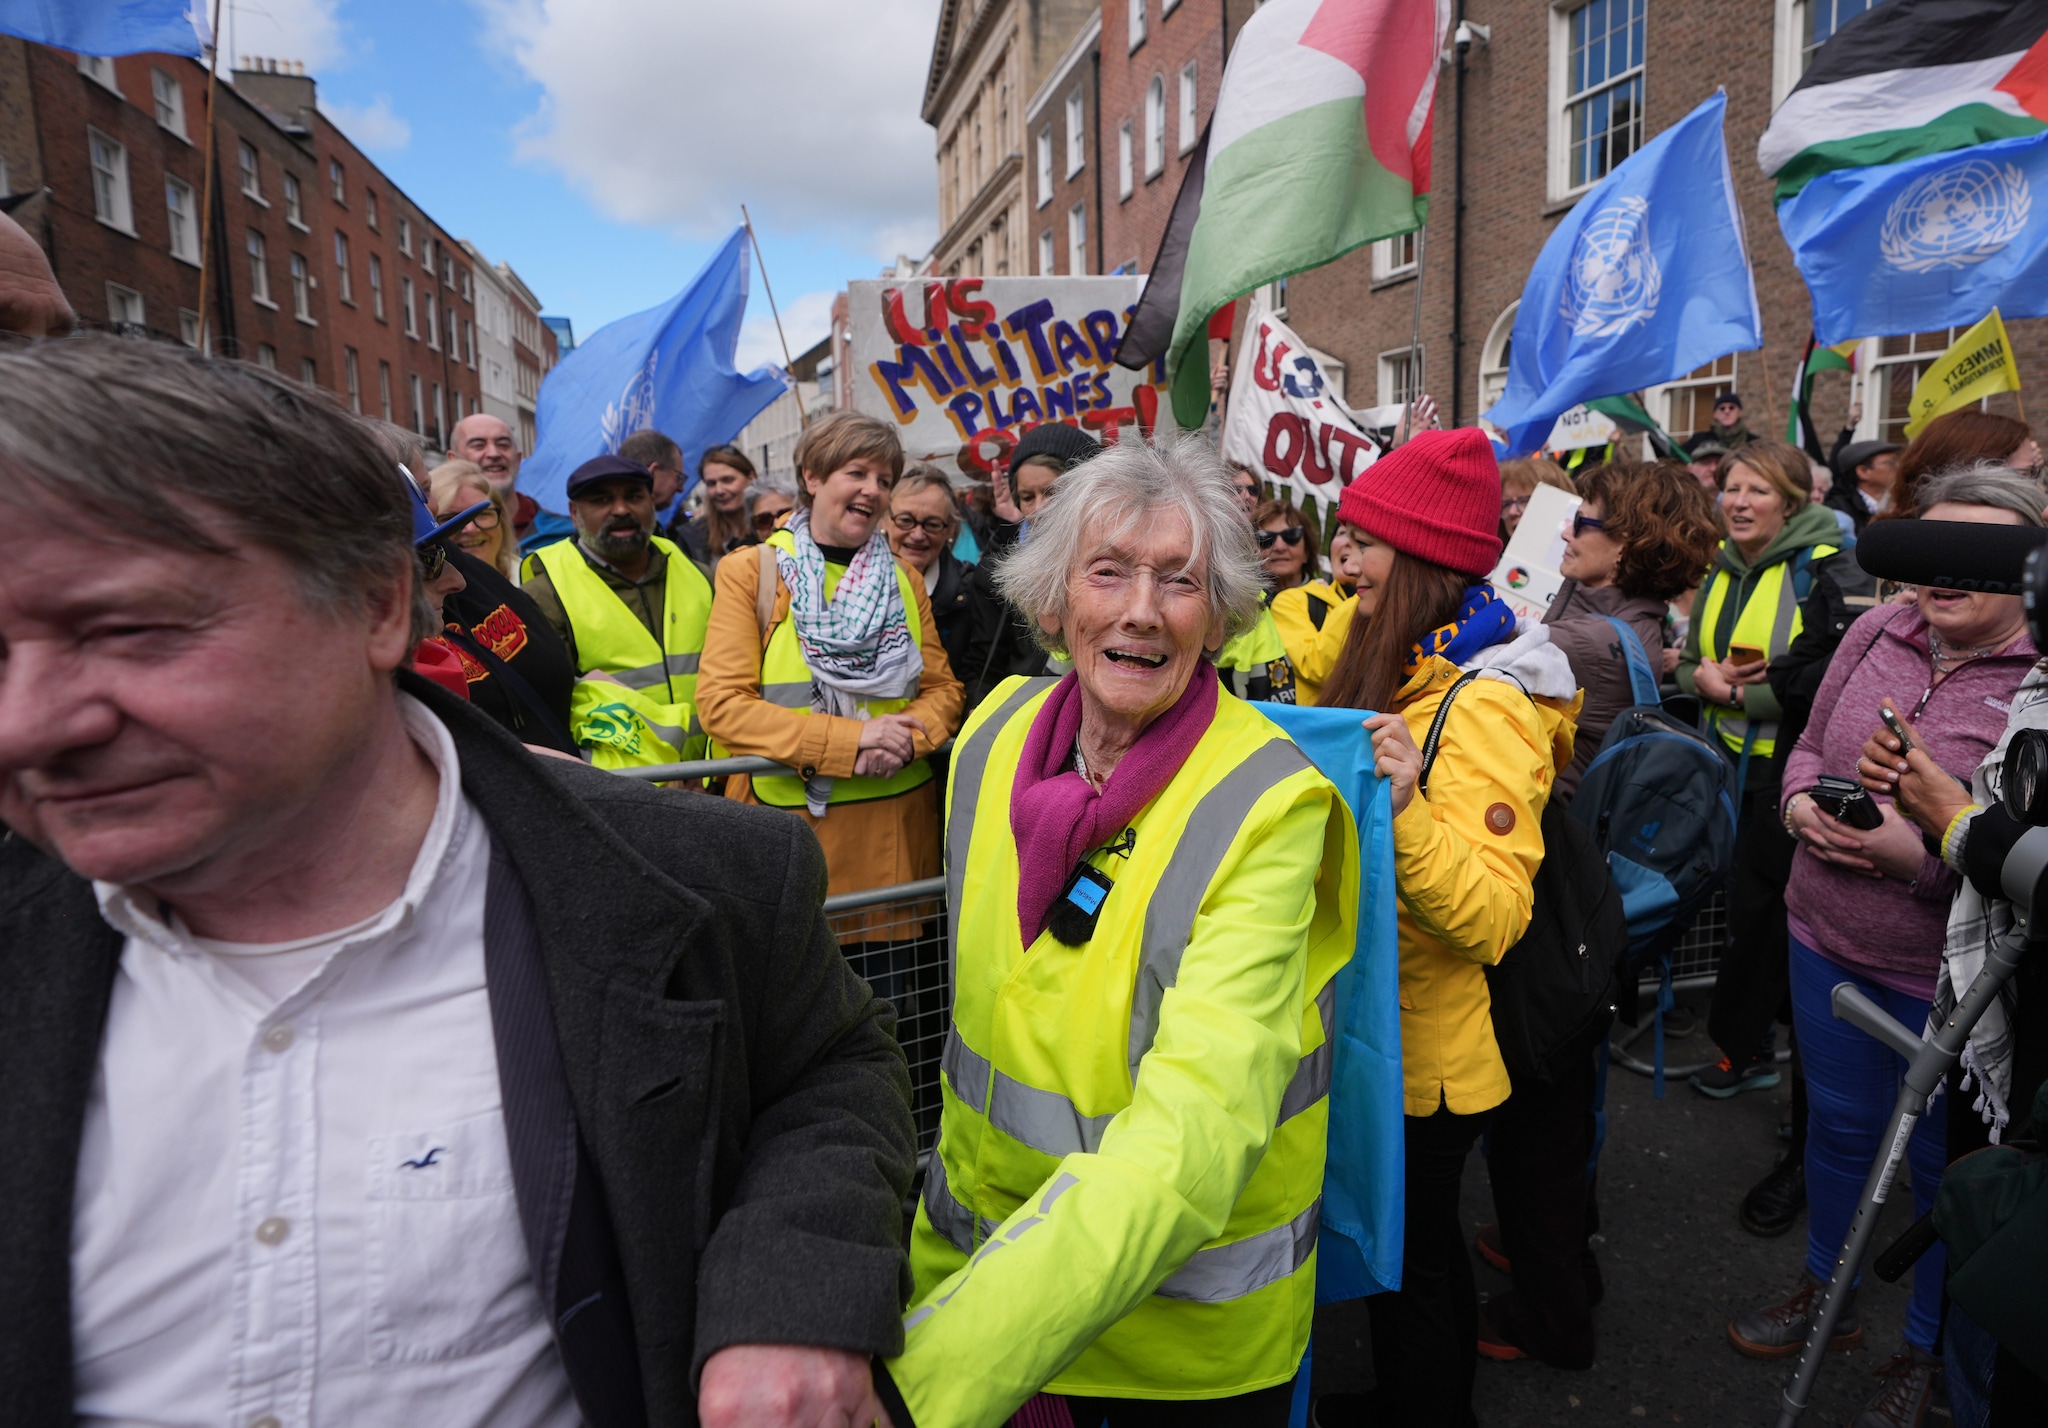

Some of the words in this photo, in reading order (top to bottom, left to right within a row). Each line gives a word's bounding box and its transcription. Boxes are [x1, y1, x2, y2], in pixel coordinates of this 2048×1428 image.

[881, 278, 995, 346] US
[945, 371, 1113, 441] PLANES
[957, 384, 1159, 482] OT!
[1562, 410, 1590, 426] NOT
[1263, 412, 1372, 487] OUT
